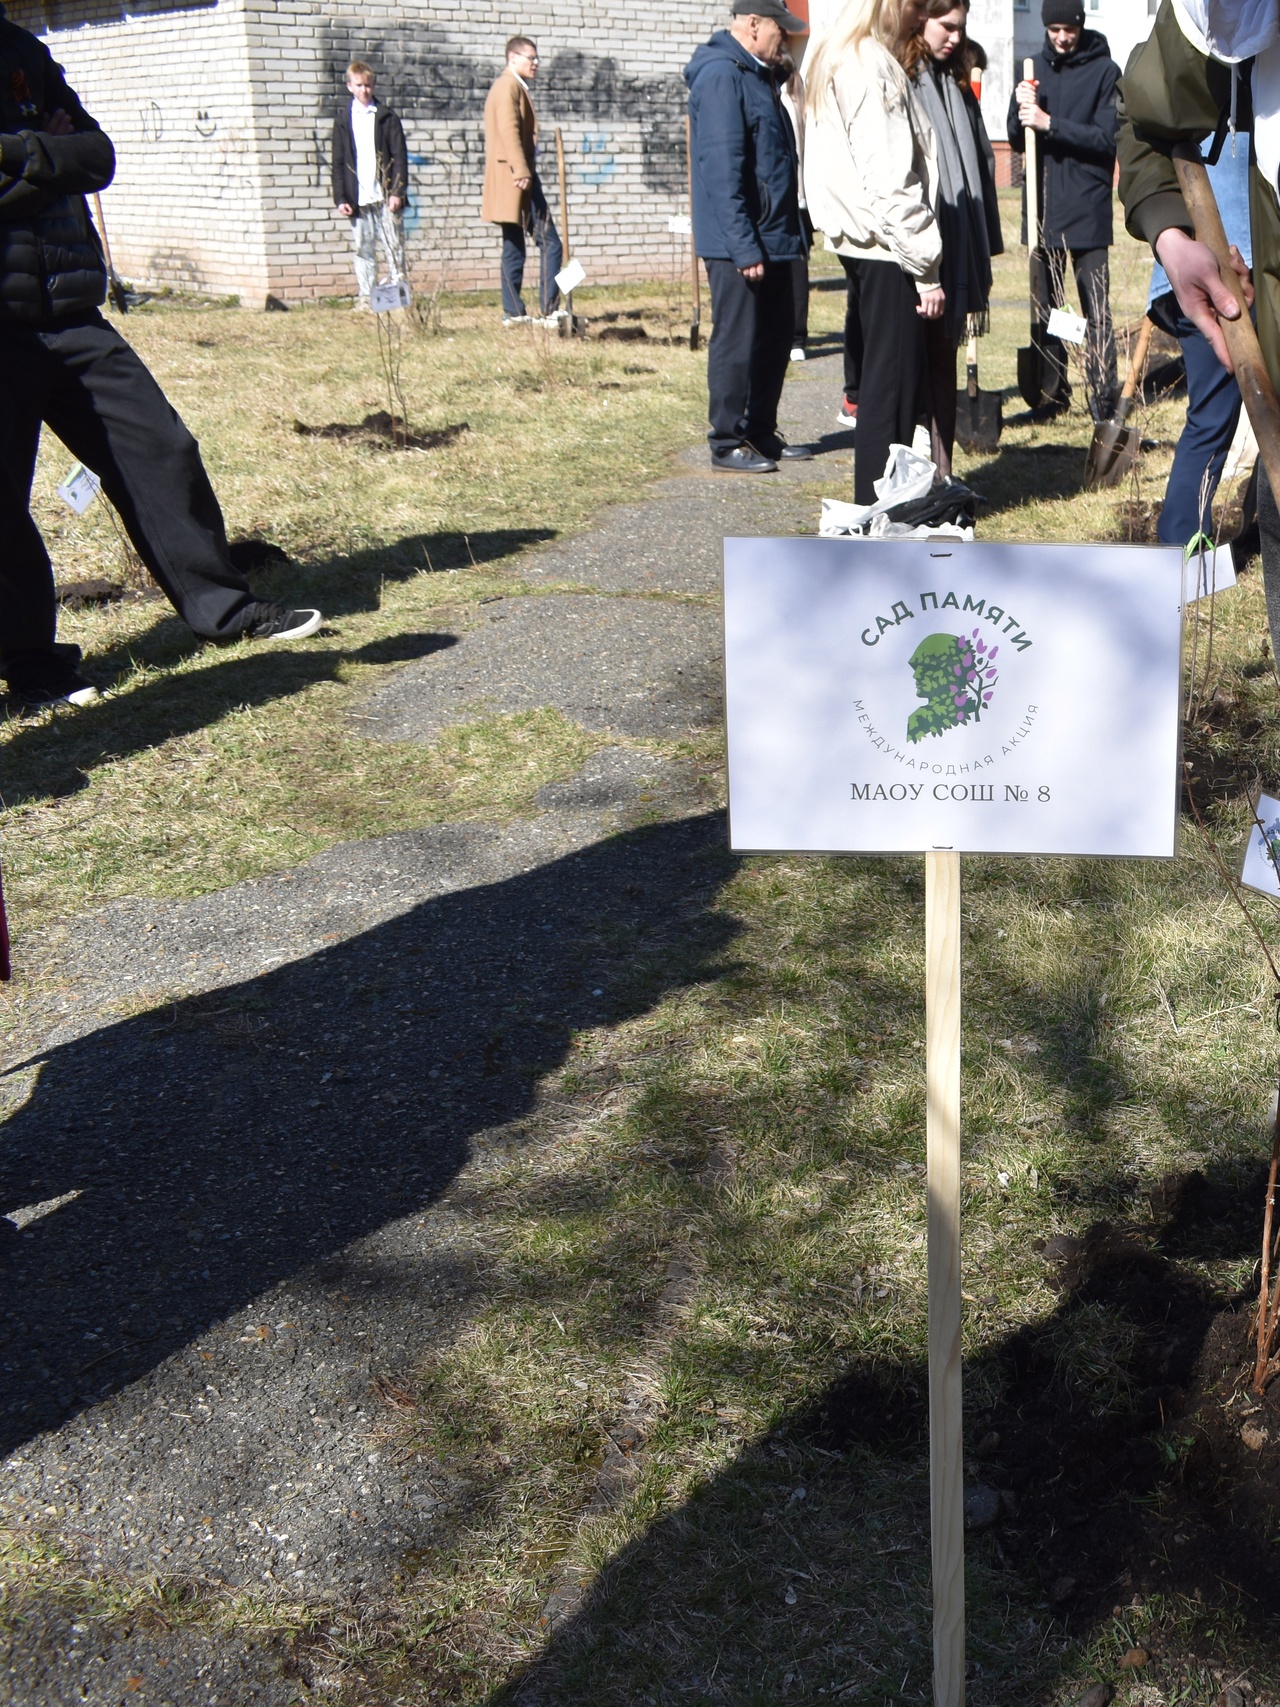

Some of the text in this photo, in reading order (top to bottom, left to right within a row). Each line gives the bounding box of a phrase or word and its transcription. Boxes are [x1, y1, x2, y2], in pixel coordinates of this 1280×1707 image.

[861, 591, 1033, 653] САД ПАМЯТИ
[853, 699, 1039, 776] МЕЖДУНАРОДНАЯ АКЦИЯ
[850, 783, 1051, 803] МАОУ СОШ № 8
